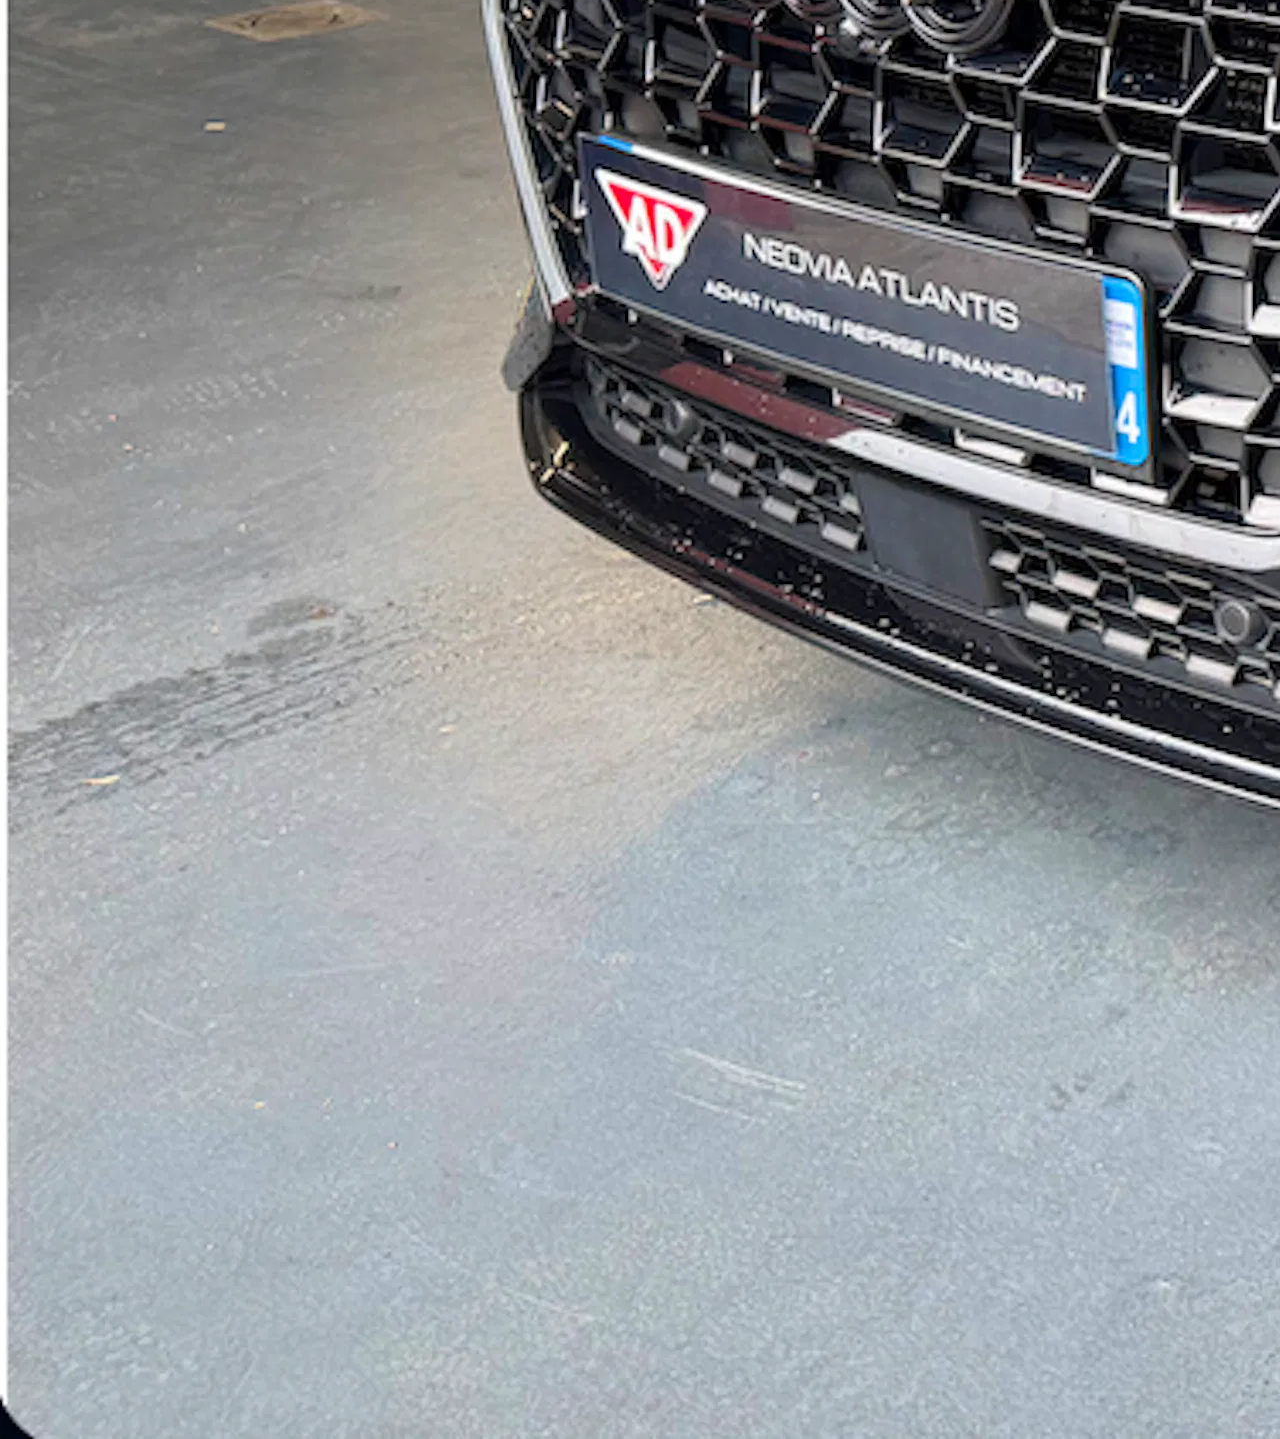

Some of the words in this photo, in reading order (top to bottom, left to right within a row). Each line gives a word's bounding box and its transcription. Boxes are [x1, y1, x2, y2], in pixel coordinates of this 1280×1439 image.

[622, 195, 686, 266] AD
[743, 232, 854, 288] NEOVIA
[857, 264, 1021, 332] ATLANTIS
[703, 278, 761, 311] ACHAT
[841, 317, 927, 361] REPRISE
[937, 344, 1088, 403] FINANCEMENT
[1117, 391, 1141, 444] 4
